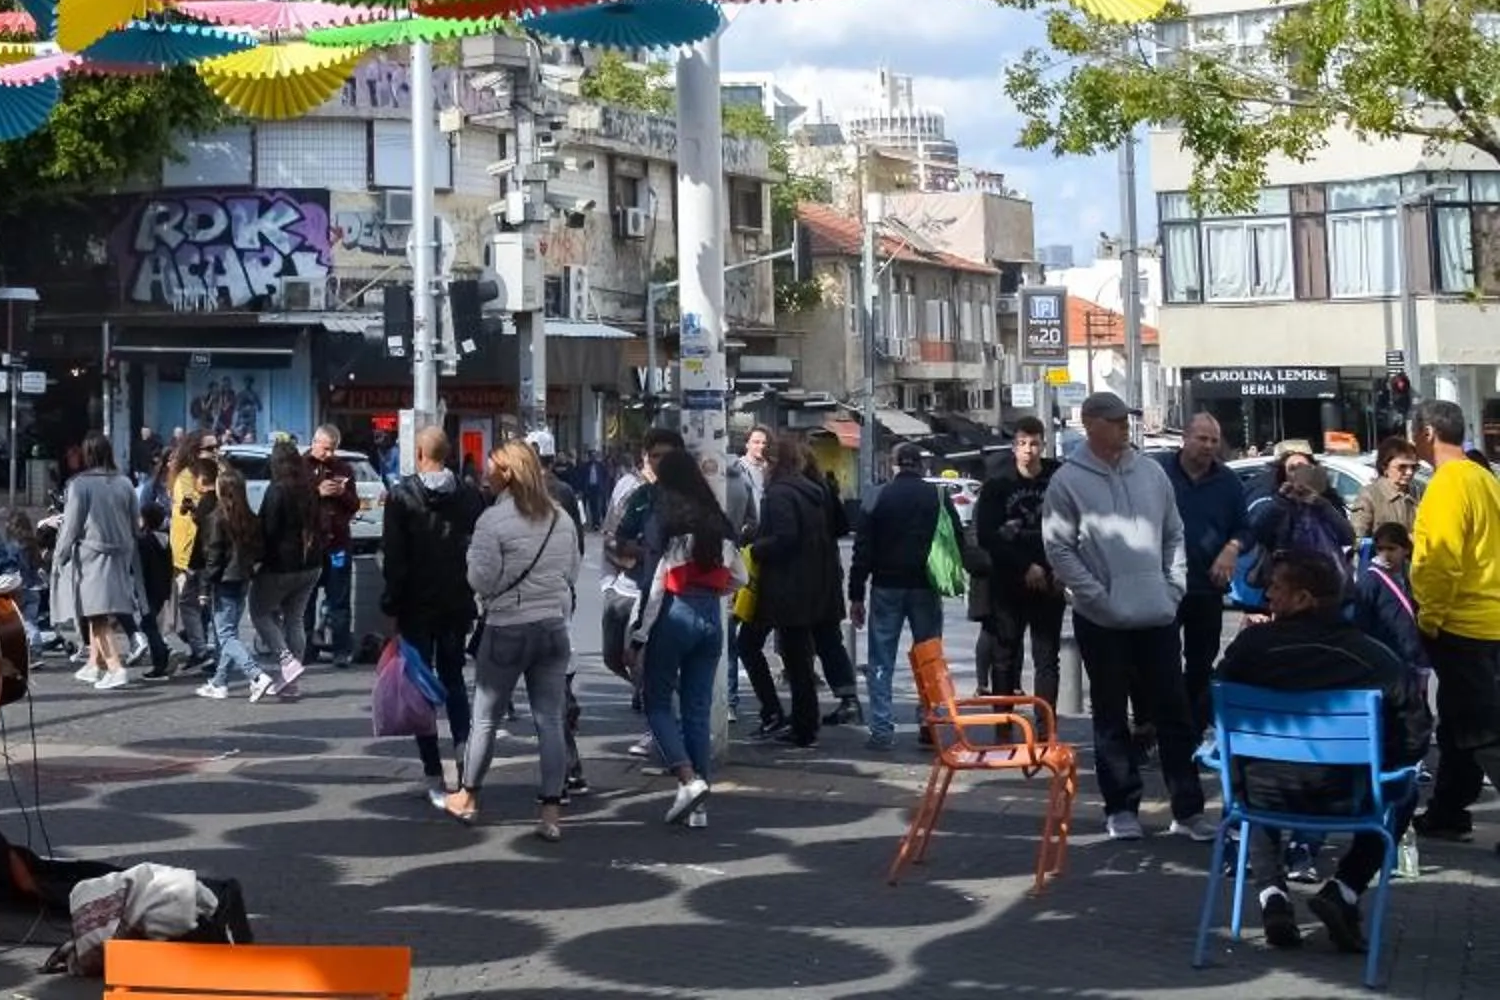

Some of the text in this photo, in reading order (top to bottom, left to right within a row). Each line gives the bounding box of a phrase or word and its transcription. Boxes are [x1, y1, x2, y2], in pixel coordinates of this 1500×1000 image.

[1039, 327, 1061, 343] 20
[1200, 370, 1327, 382] CAROLINA LEMKE
[1241, 384, 1286, 395] BERLIN
